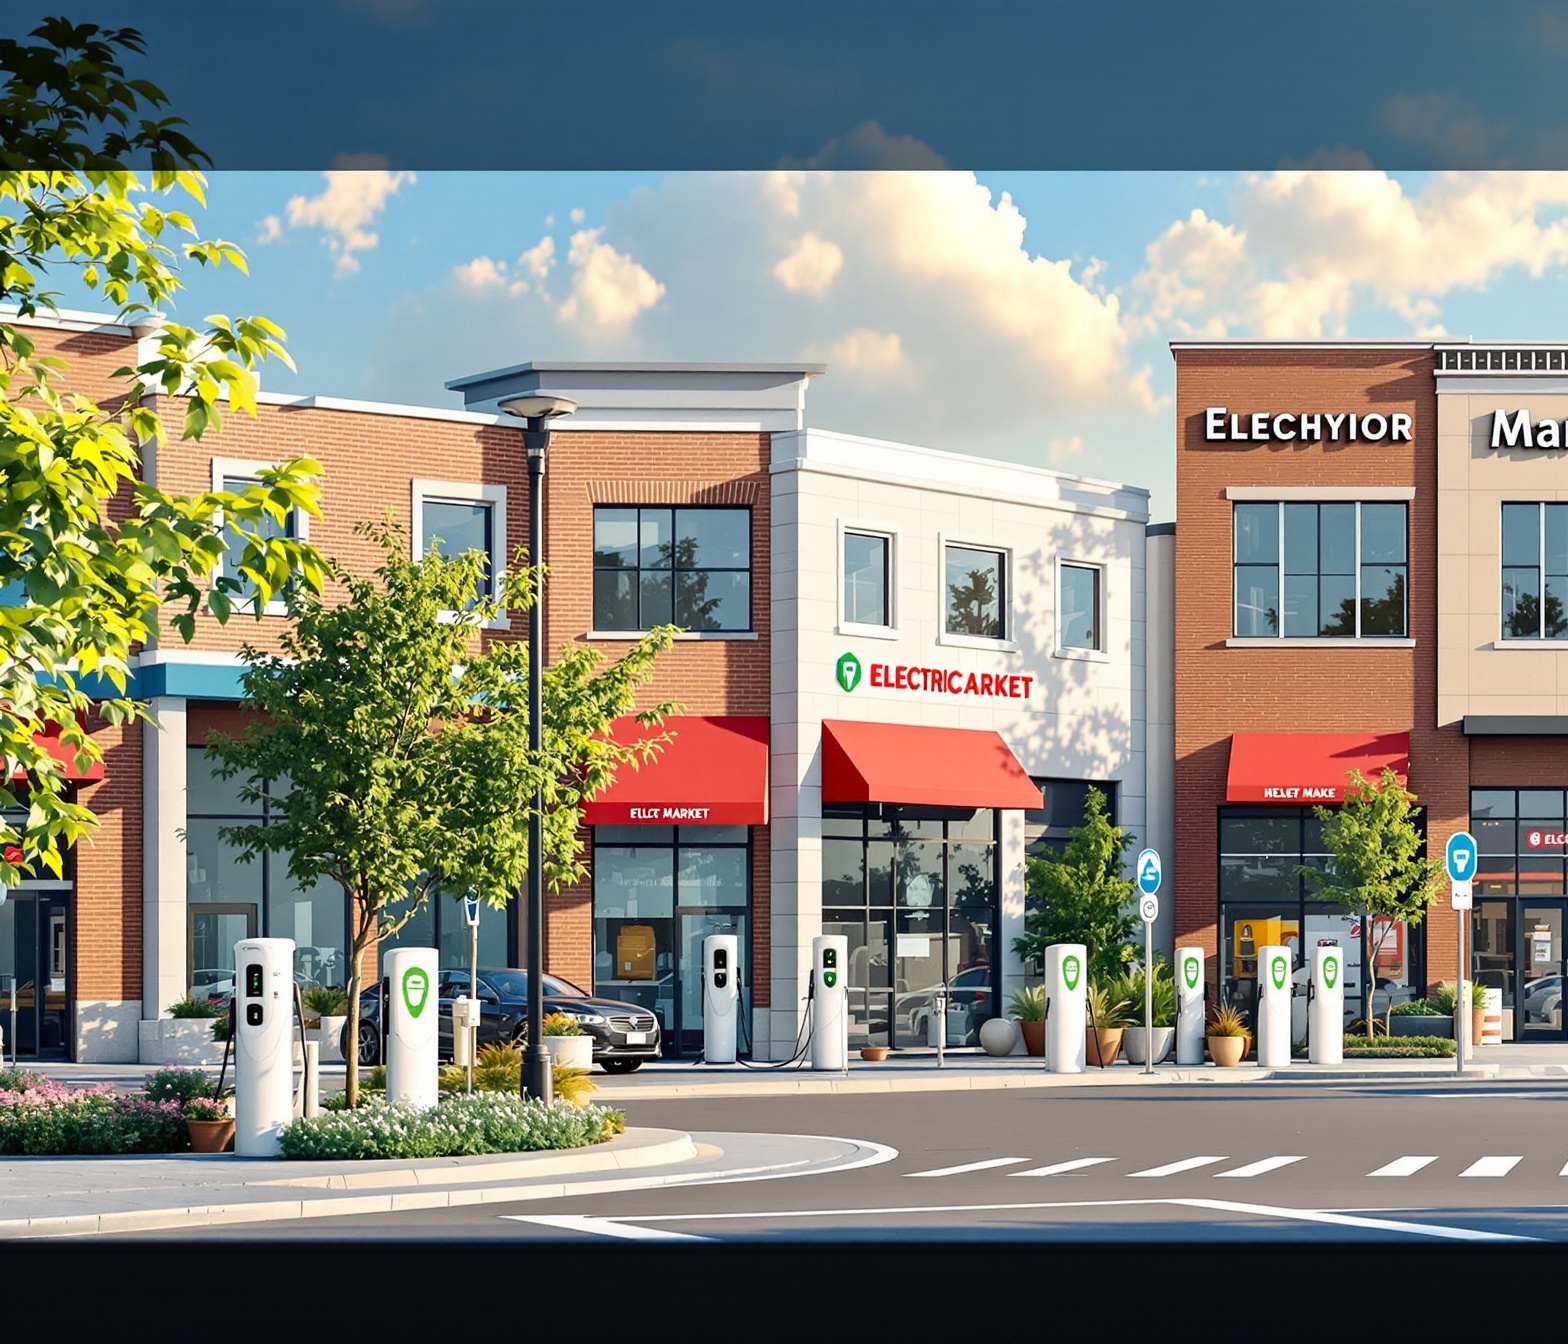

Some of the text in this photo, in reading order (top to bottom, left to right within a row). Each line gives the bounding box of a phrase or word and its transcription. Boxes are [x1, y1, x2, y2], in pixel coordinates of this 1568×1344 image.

[1204, 406, 1413, 442] ELECHYIOR
[1302, 787, 1336, 798] MAKE
[662, 807, 710, 819] MARKET
